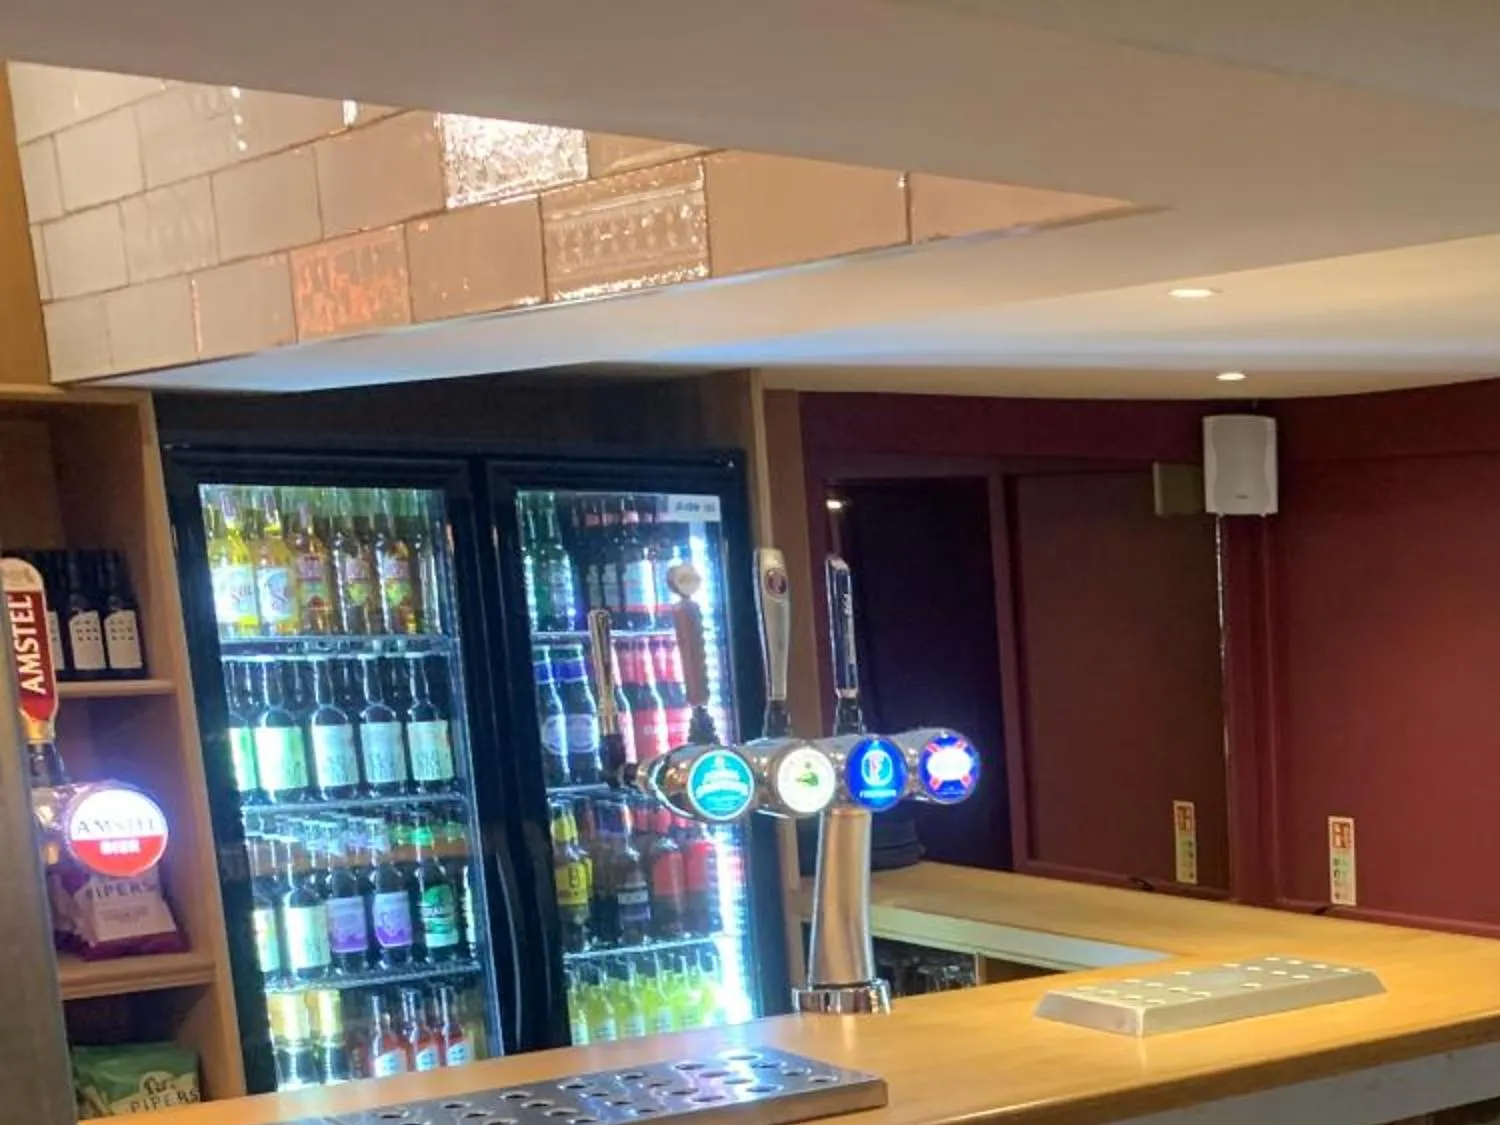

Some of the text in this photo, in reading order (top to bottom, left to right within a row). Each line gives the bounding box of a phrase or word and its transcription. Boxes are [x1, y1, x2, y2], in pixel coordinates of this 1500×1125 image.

[8, 593, 47, 695] AMSTEL
[85, 878, 157, 898] PIPERS
[128, 1088, 200, 1114] PIPERS
